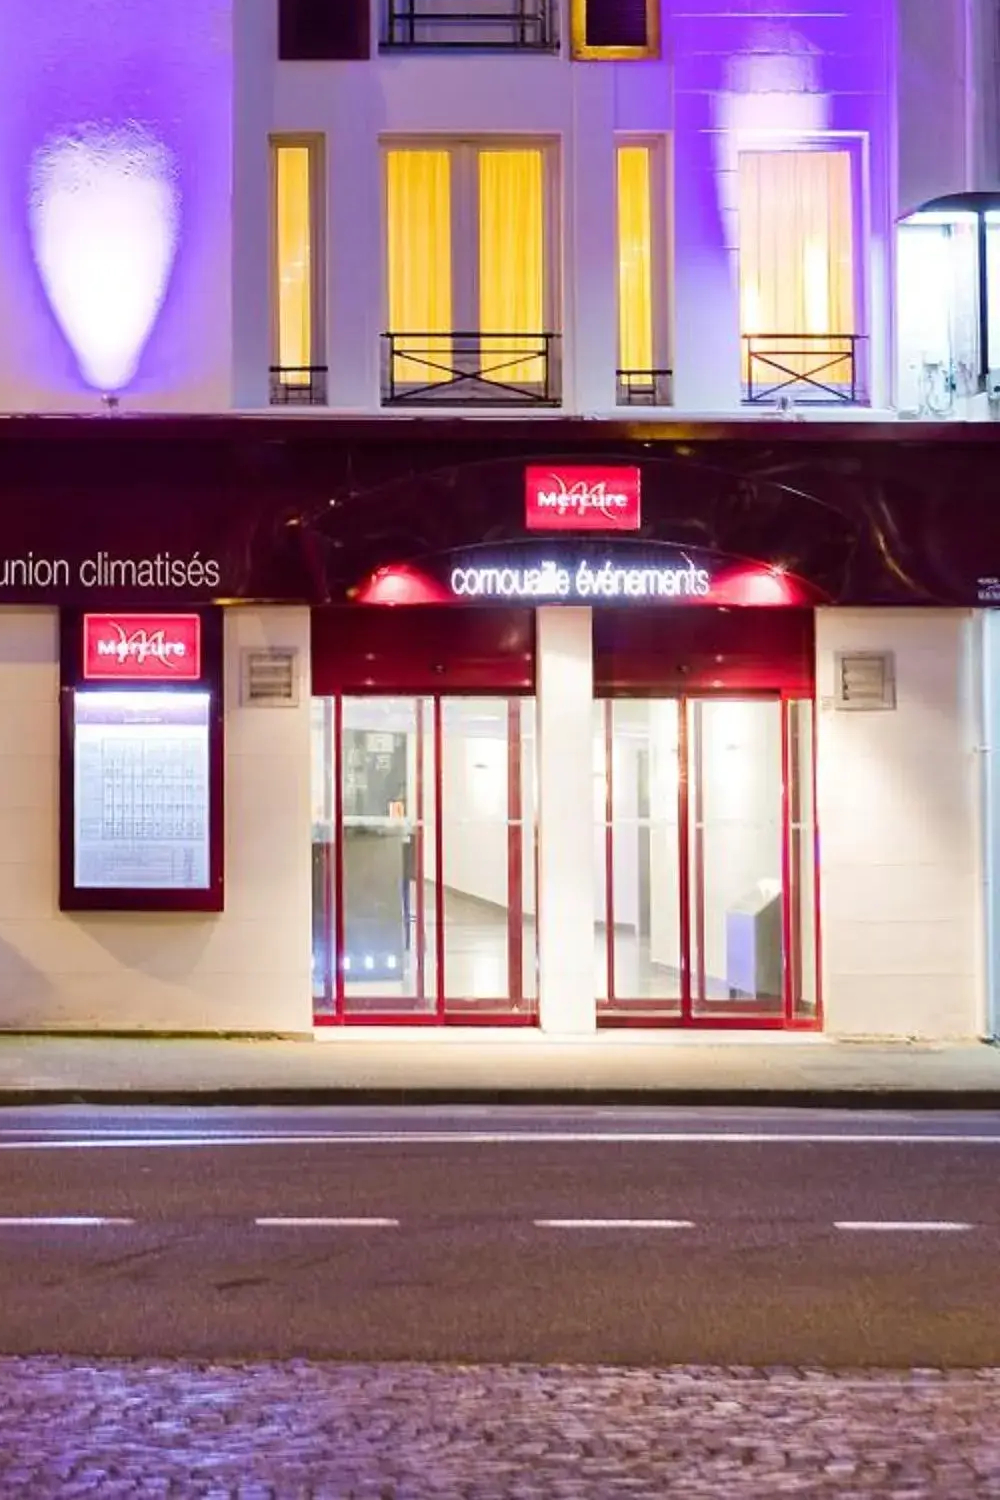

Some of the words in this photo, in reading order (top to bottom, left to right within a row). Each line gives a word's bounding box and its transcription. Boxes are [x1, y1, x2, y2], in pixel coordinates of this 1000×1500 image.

[537, 491, 629, 508] Mercure
[79, 551, 221, 587] climatisés
[575, 560, 711, 596] événements
